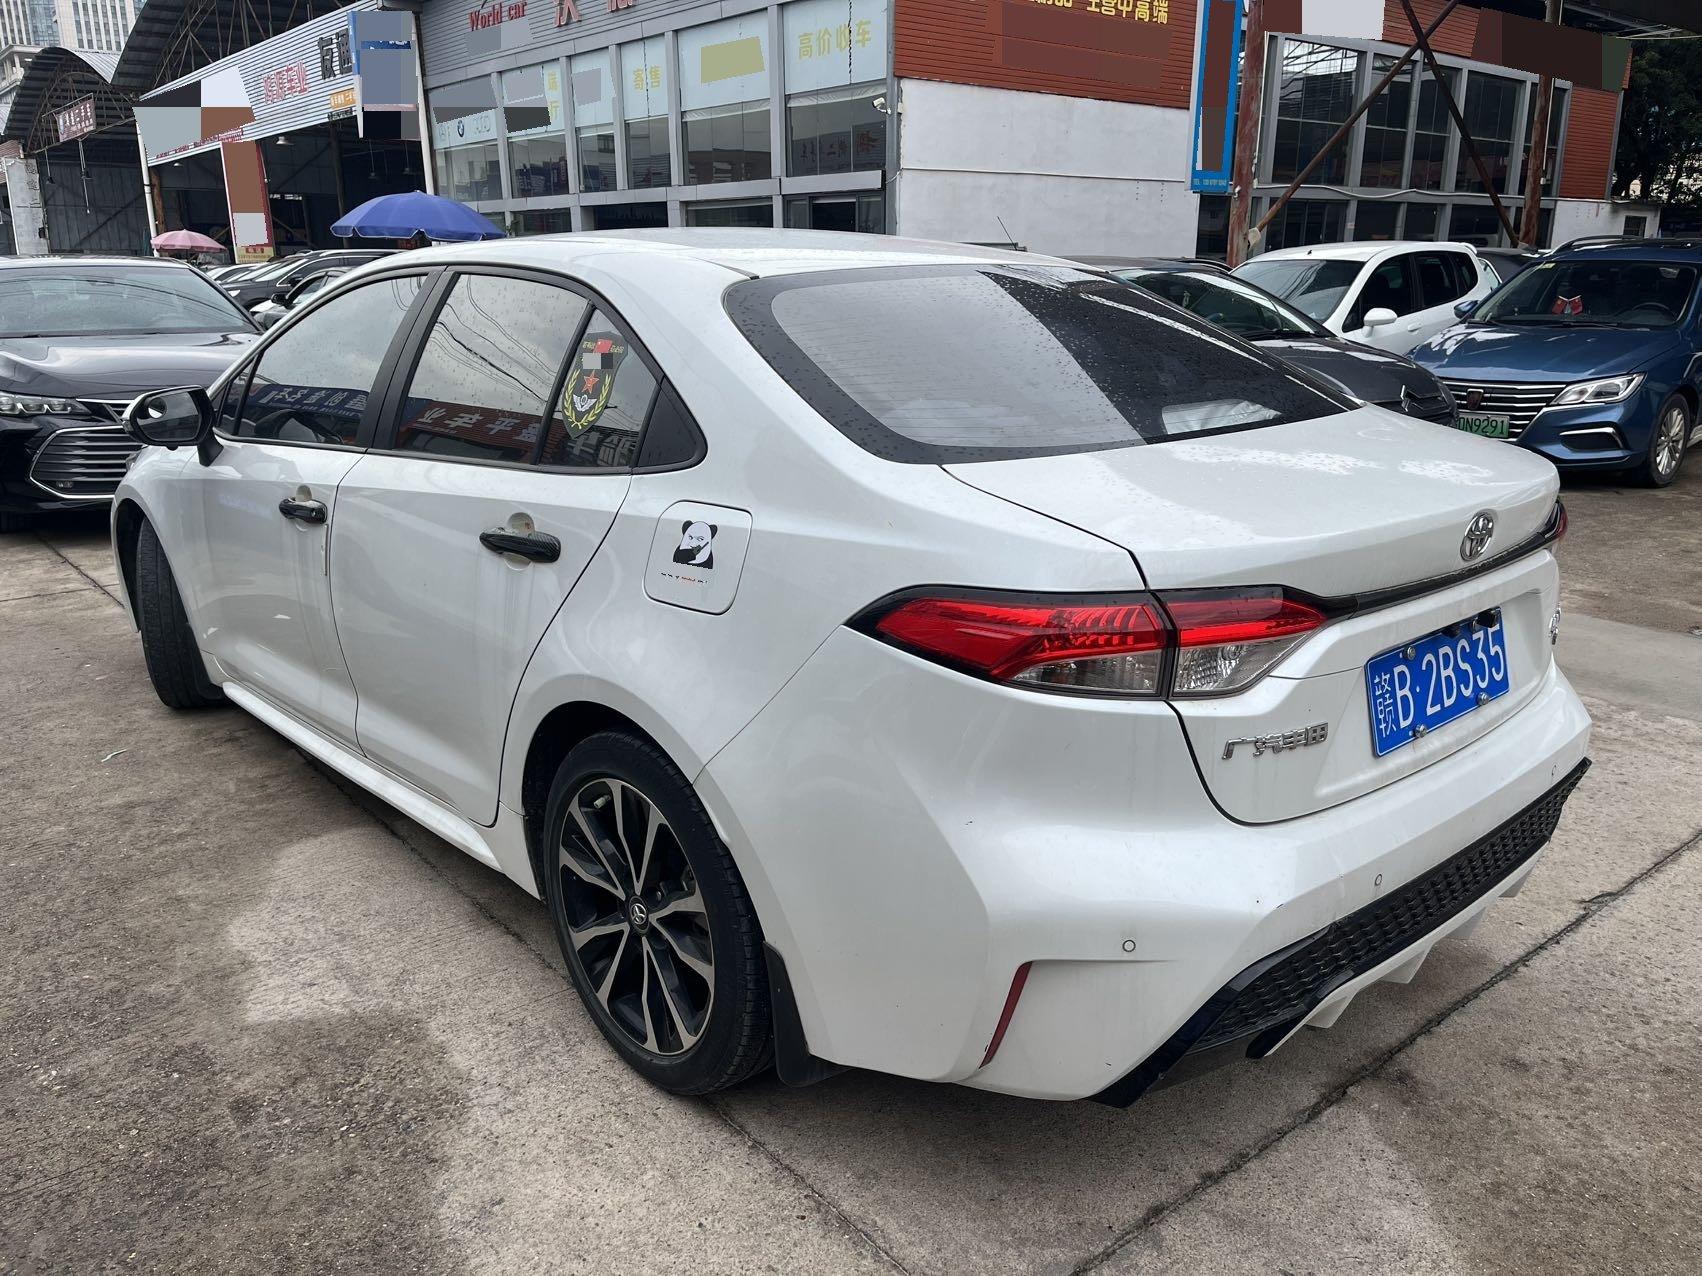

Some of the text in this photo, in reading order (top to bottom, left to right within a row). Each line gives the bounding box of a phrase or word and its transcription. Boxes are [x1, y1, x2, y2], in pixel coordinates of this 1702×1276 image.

[468, 2, 528, 31] World car
[798, 19, 871, 59] 高价收车
